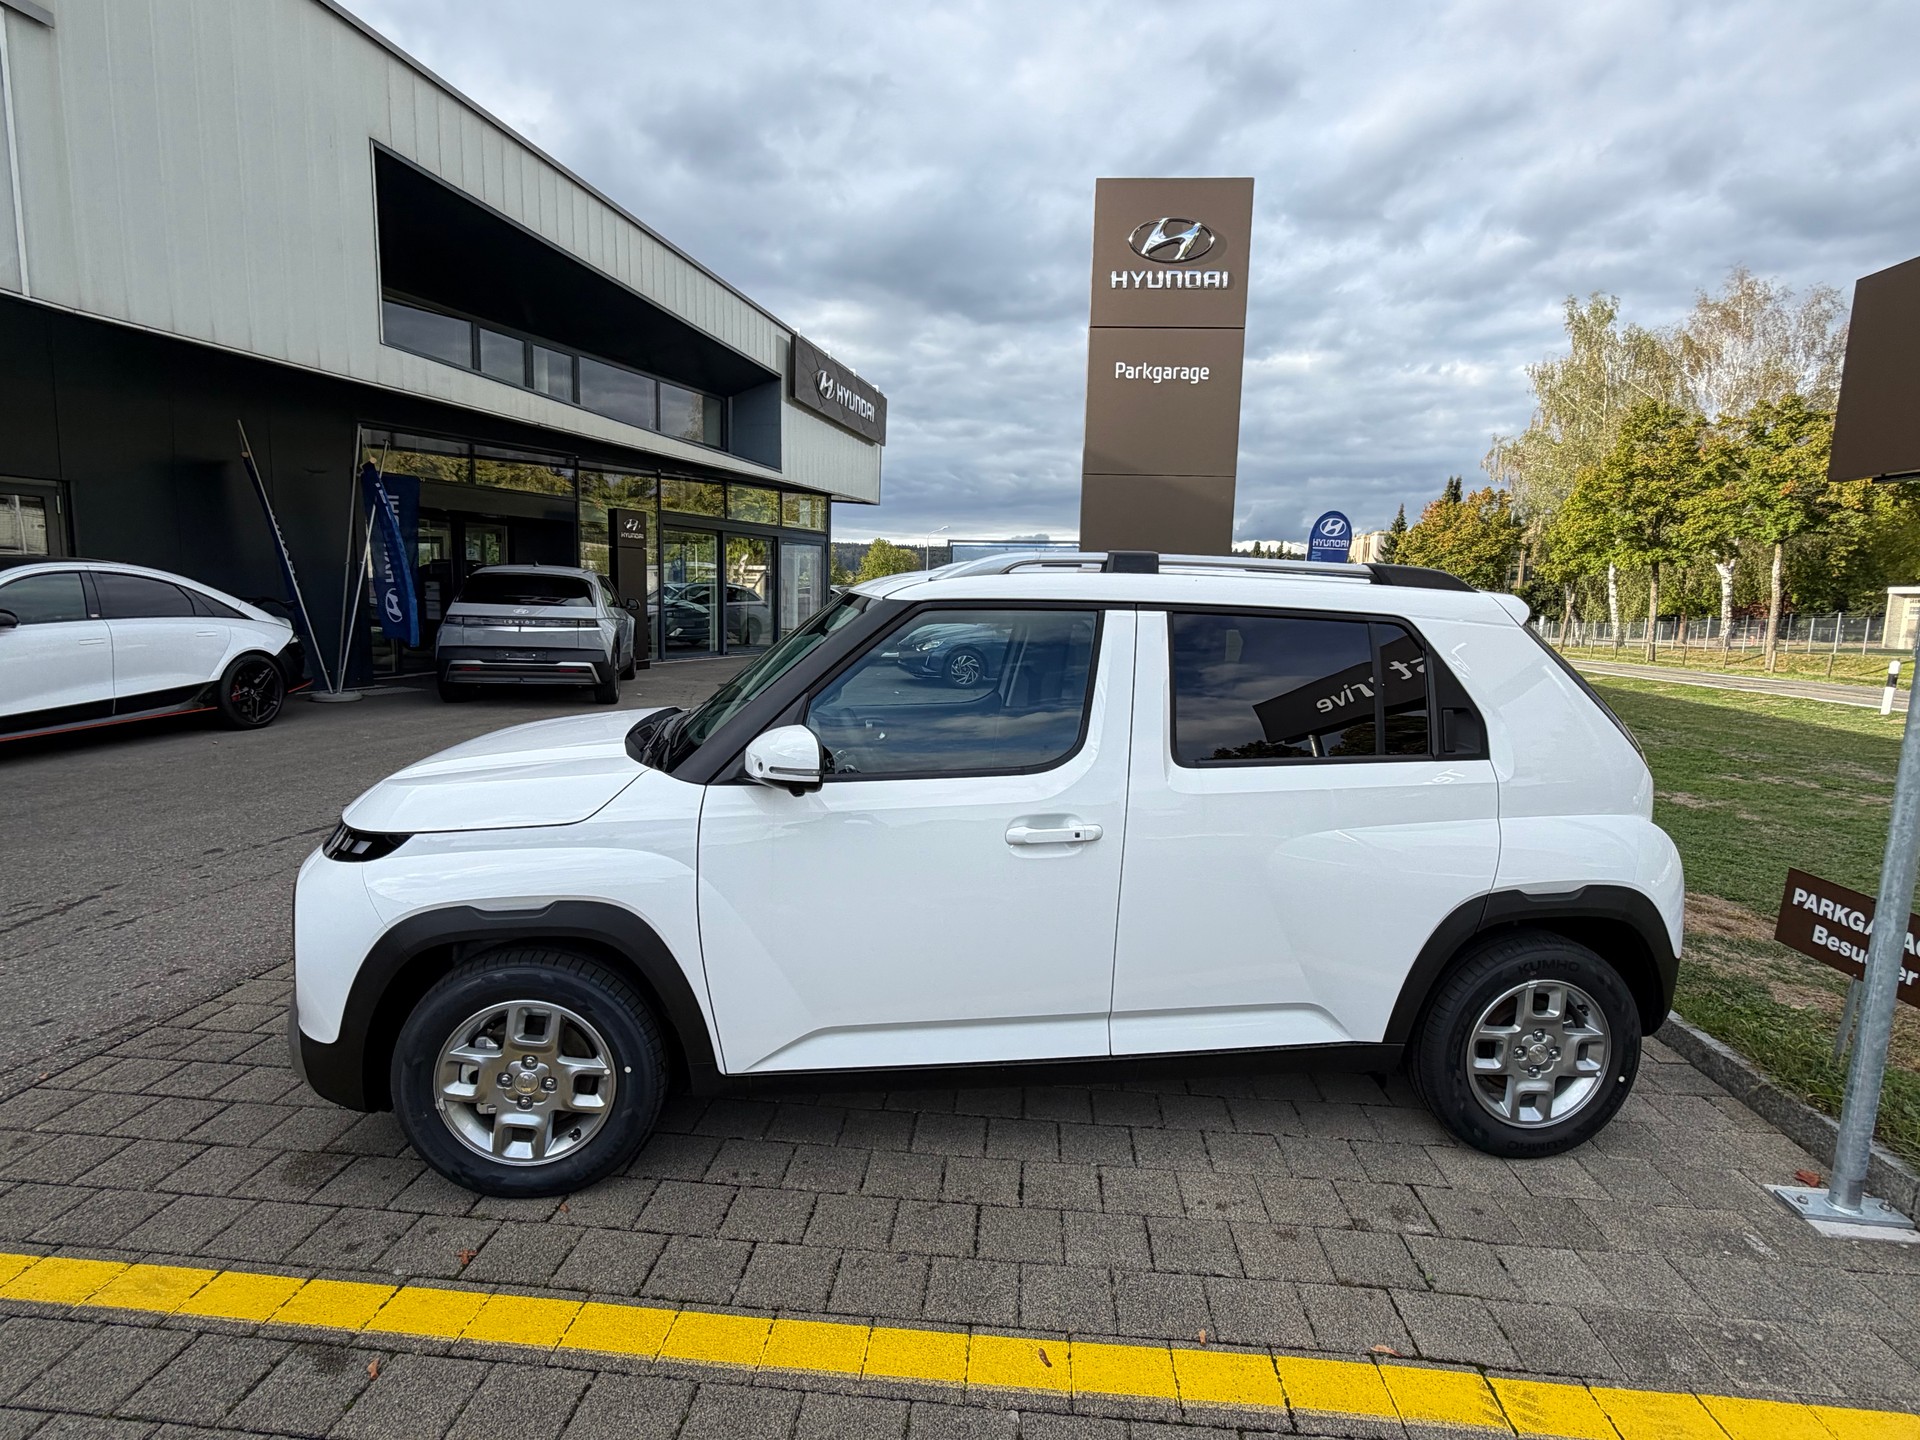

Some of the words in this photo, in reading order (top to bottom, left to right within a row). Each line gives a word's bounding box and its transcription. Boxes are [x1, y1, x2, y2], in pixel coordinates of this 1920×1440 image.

[1110, 270, 1229, 289] HYUNDAI
[1115, 361, 1210, 384] Parkgarage
[836, 382, 875, 423] HYUNDAI
[620, 532, 645, 540] HYUNDAI
[1312, 538, 1349, 548] HYUNDAI
[1792, 887, 1920, 957] PARKGA
[1812, 924, 1919, 986] Besuer
[1518, 959, 1580, 975] KUMHO
